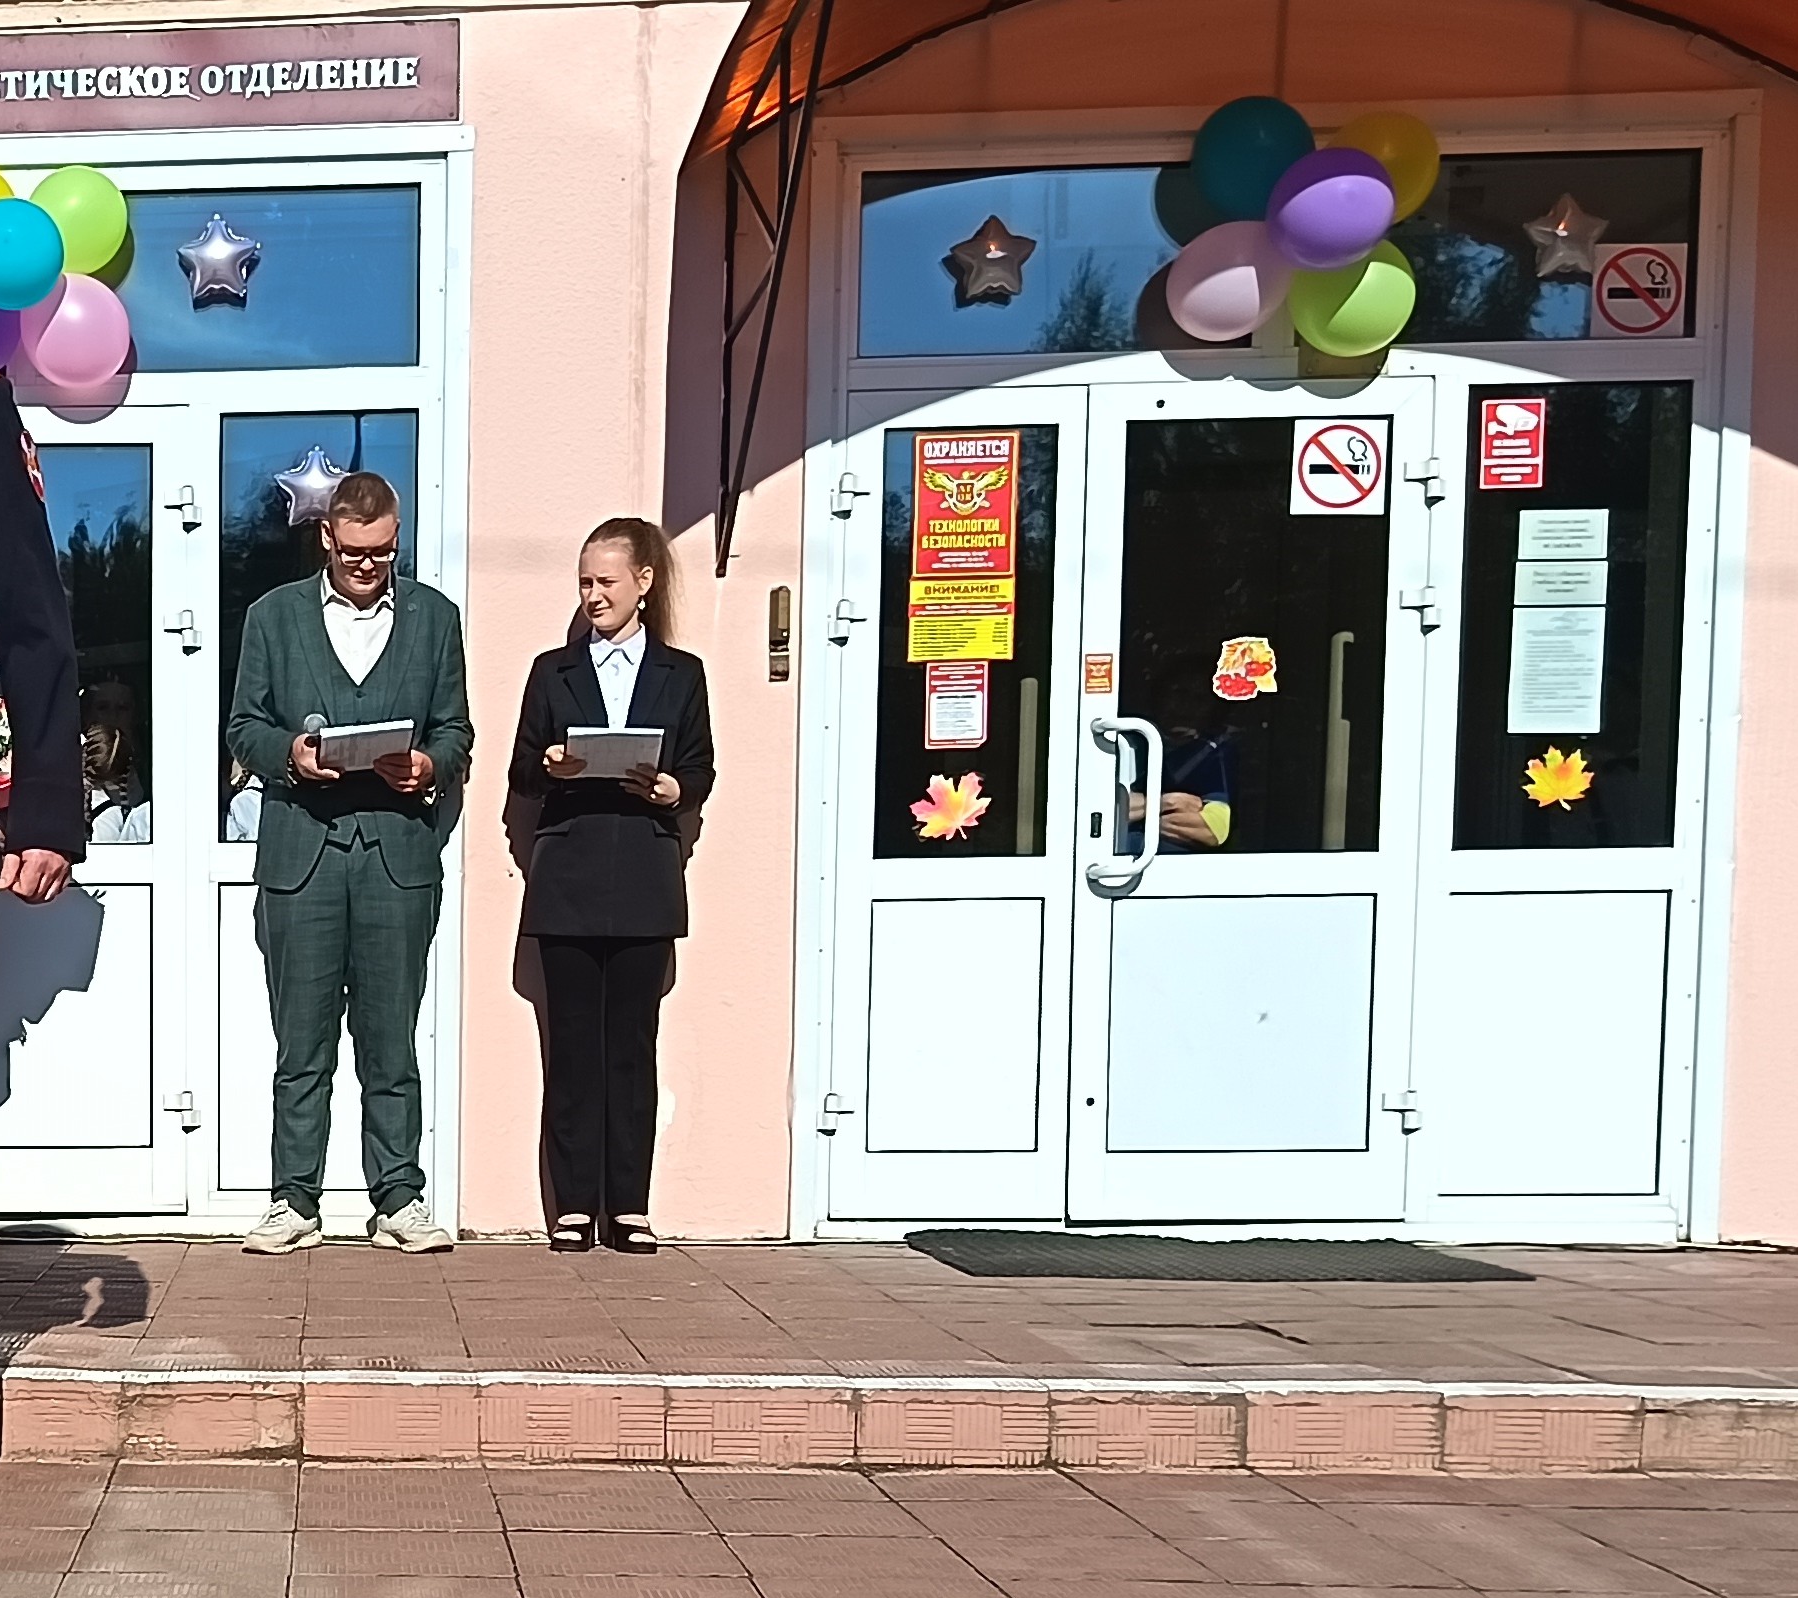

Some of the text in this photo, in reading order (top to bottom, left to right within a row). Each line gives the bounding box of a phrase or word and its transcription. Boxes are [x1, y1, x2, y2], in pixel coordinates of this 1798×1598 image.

[199, 58, 419, 99] ОТДЕЛЕНИЕ
[923, 440, 1010, 458] ОХРАНЯЕТСЯ
[929, 518, 1000, 533] ТЕХНОЛОГИИ
[921, 534, 1006, 549] БЕЗОПАСНОСТИ
[924, 585, 999, 595] ВНИМАНИЕ!
